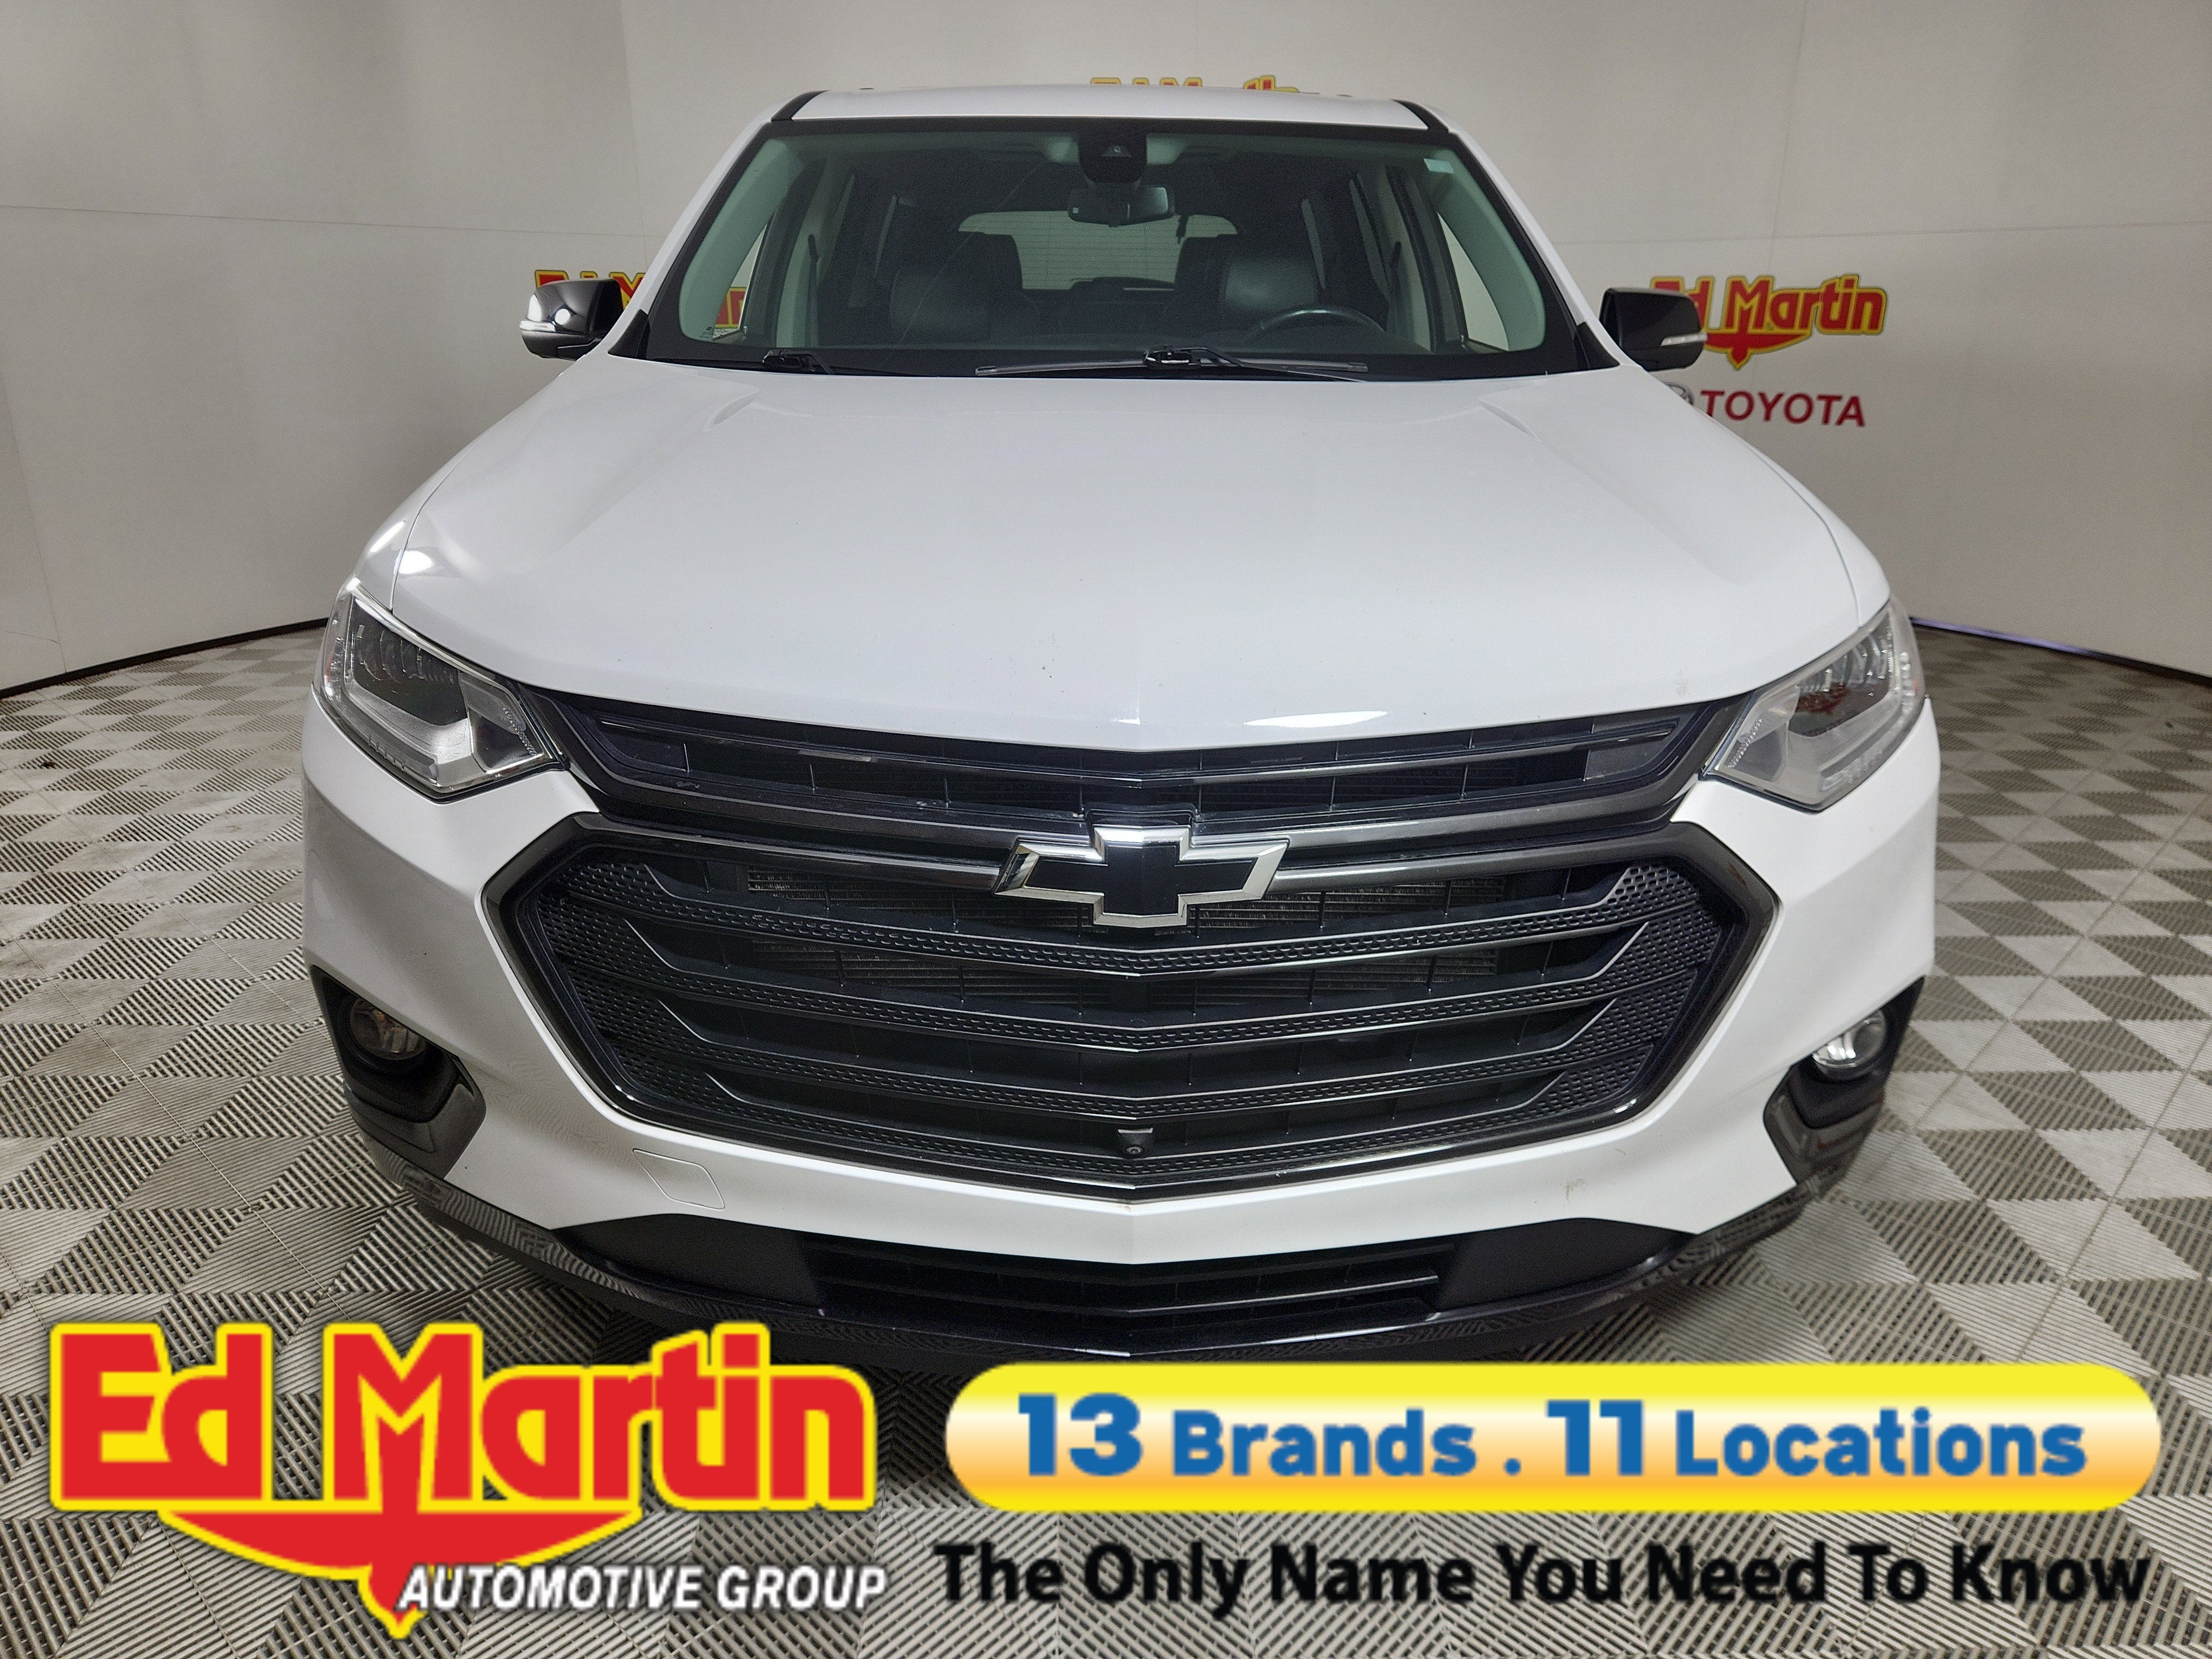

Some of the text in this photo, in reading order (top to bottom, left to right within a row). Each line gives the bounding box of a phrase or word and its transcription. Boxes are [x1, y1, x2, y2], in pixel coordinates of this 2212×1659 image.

[1651, 274, 1887, 335] d Martin
[1701, 390, 1865, 427] TOYOTA
